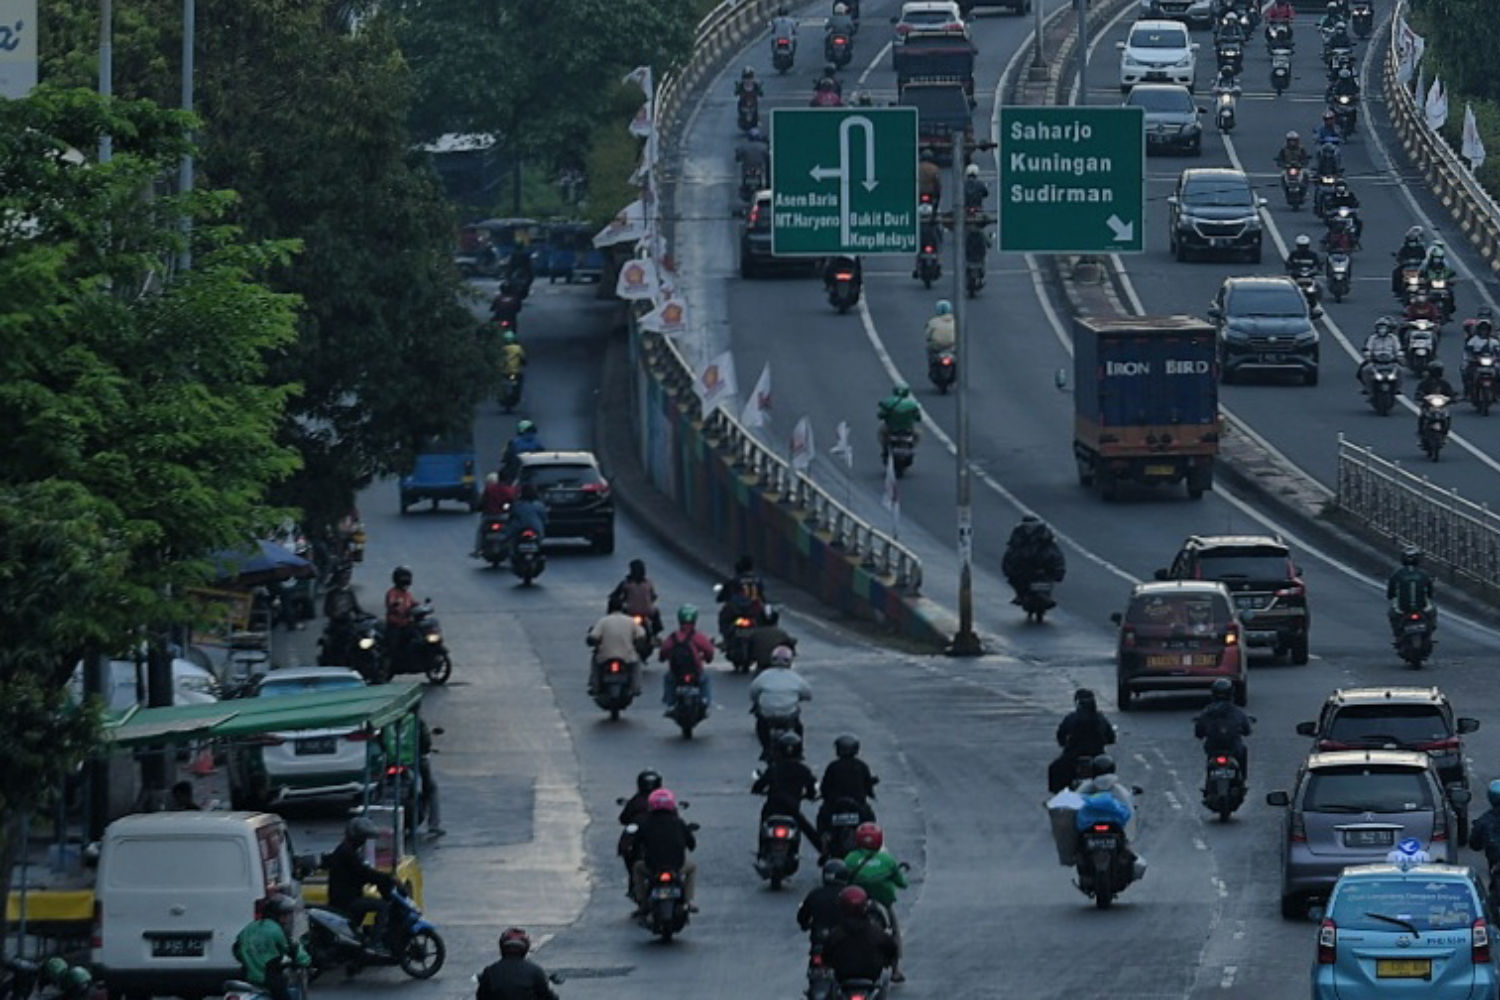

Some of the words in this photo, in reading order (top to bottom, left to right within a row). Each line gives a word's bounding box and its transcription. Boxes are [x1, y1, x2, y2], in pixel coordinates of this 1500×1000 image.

[1010, 120, 1092, 143] Saharjo
[1010, 152, 1112, 176] Kuningan
[1010, 183, 1114, 203] Sudirman
[850, 211, 881, 227] Bukit
[884, 211, 909, 227] Duri
[1105, 360, 1150, 376] IRON
[1165, 358, 1209, 375] BIRD
